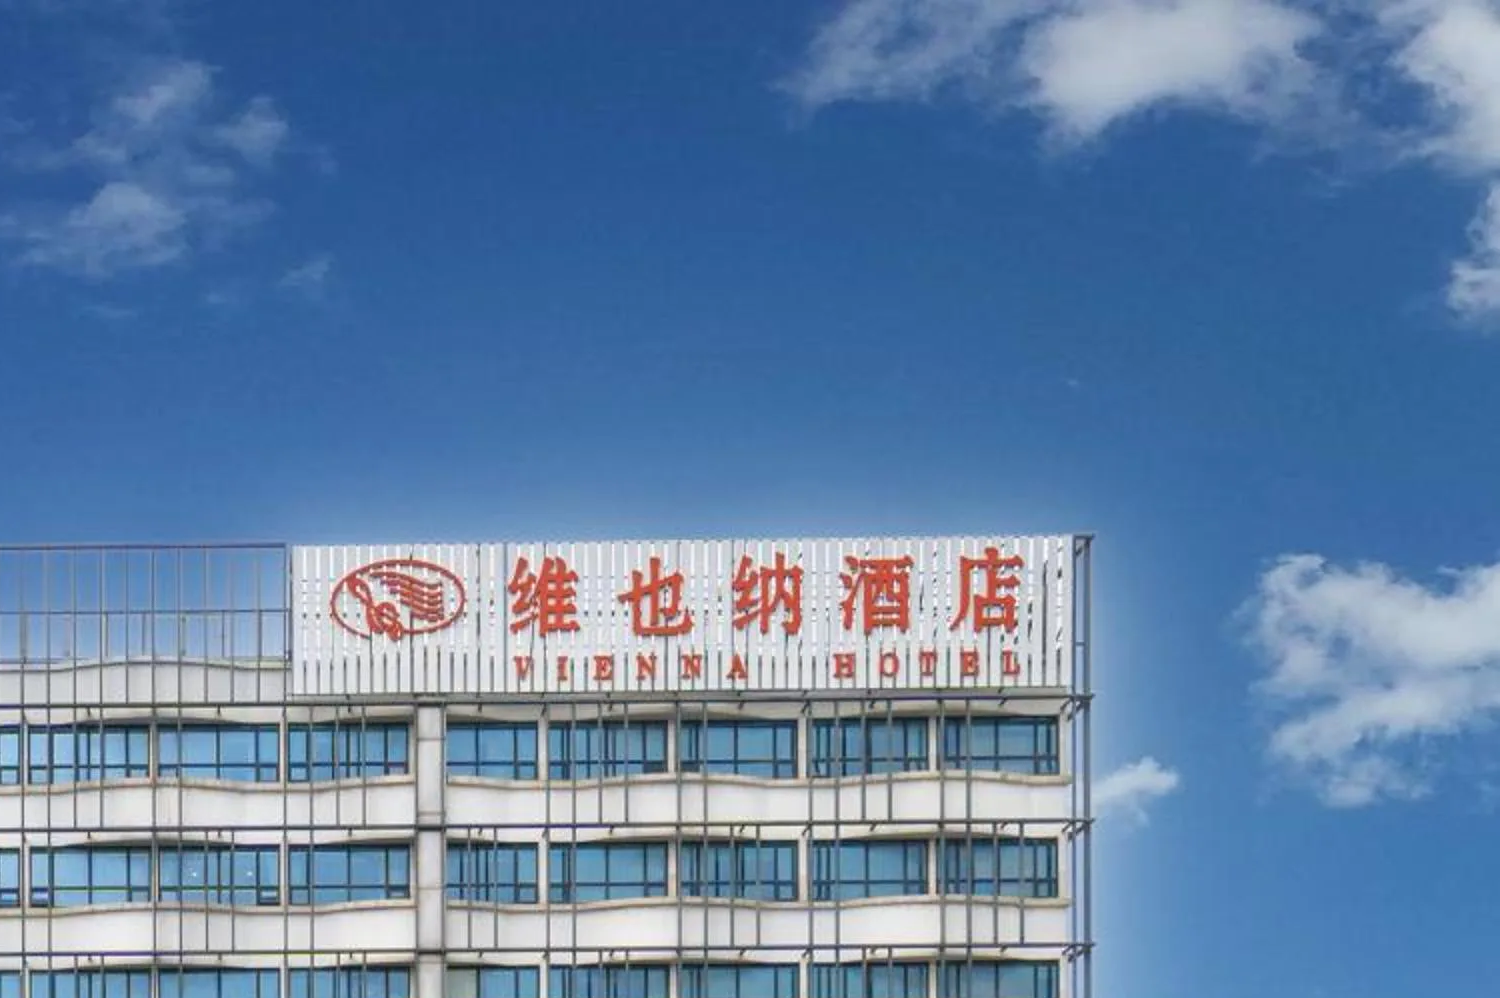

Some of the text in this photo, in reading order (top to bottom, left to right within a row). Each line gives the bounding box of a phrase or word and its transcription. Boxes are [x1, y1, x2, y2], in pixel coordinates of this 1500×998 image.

[507, 546, 1025, 638] 维也纳酒店
[514, 647, 1021, 681] VIENNA HOTEL
